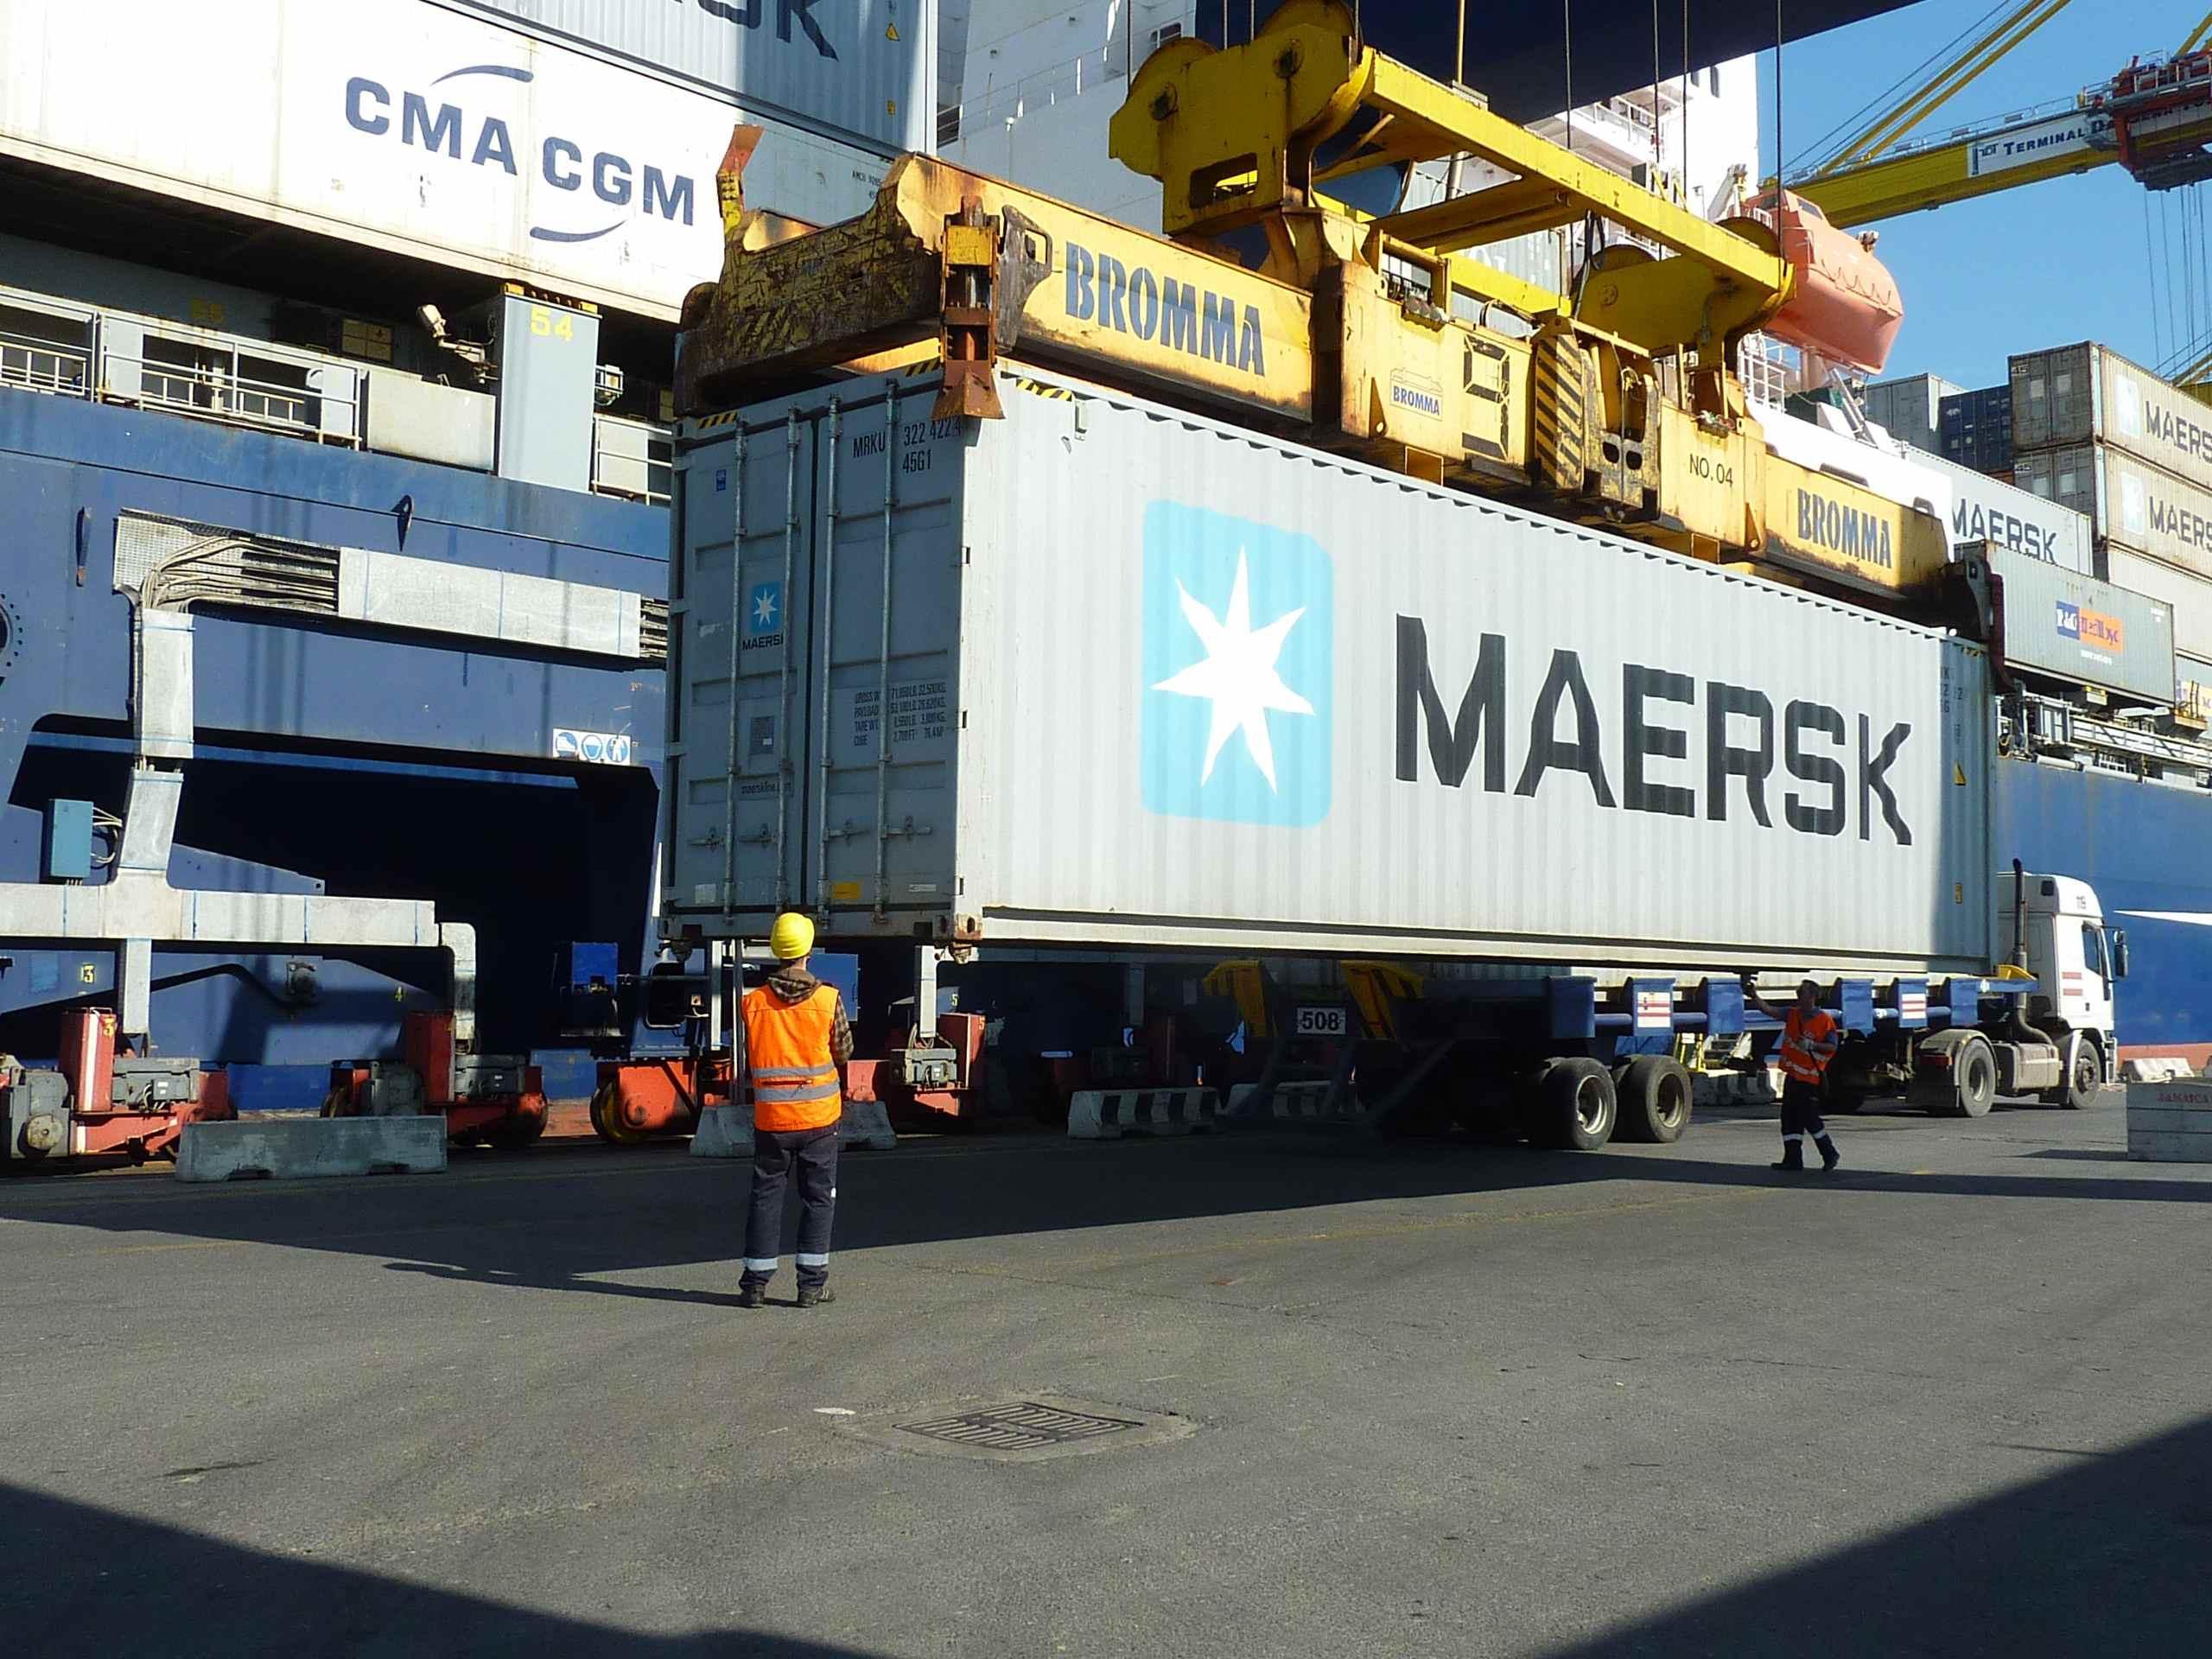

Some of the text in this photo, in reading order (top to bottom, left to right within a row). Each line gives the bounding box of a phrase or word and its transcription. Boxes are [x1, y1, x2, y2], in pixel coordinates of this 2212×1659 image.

[346, 76, 695, 226] CMA CGM
[2003, 127, 2085, 156] TERMINAL
[530, 305, 574, 341] 54
[1065, 241, 1265, 378] BROMMA
[1392, 385, 1440, 416] BROMMA
[853, 431, 887, 459] MRKU
[903, 422, 926, 447] 322
[902, 448, 932, 474] 45G1
[1797, 487, 1891, 569] BROMMA
[1395, 613, 1912, 847] MAERSK
[1301, 1010, 1340, 1032] 508
